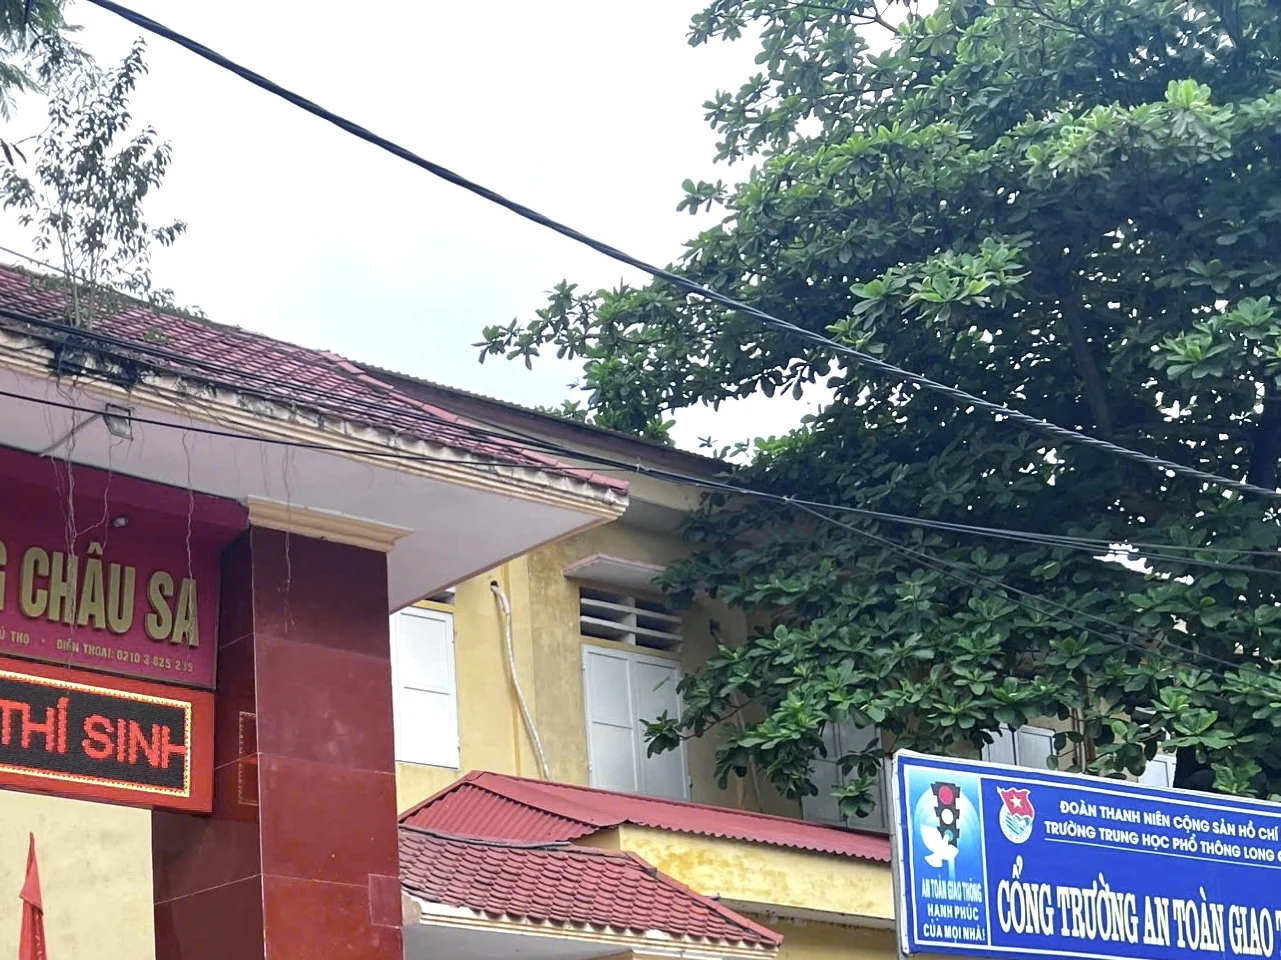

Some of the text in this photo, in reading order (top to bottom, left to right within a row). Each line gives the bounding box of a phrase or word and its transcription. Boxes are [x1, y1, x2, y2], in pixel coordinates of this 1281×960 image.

[21, 541, 137, 635] CHÂU
[146, 570, 200, 647] SA
[10, 631, 30, 645] THỌ
[117, 649, 140, 663] 0210
[144, 655, 150, 665] 3
[152, 657, 171, 669] 825
[1060, 800, 1097, 818] ĐOÀN
[1099, 806, 1140, 824] THANH
[1143, 811, 1171, 828] NIÊN
[1173, 815, 1210, 834] CỘNG
[1212, 818, 1236, 837] SẢN
[1257, 827, 1279, 842] CHÍ
[1044, 820, 1096, 840] TRƯỜNG
[1099, 827, 1139, 845] TRUNG
[1142, 834, 1170, 851] HỌC
[1172, 833, 1198, 853] PHỔ
[1200, 840, 1241, 858] THÔNG
[1244, 847, 1275, 862] LONG
[922, 874, 983, 903] AN TOÀN GIAO THÔNG
[927, 903, 979, 921] HẠNH PHÚC
[997, 855, 1055, 937] CỔNG
[1056, 872, 1139, 945] TRƯỜNG
[1143, 895, 1170, 947] AN
[1173, 886, 1224, 953] TOÀN
[1228, 903, 1274, 958] GIAO
[923, 918, 986, 943] CỦA MỌI NHÀ!
